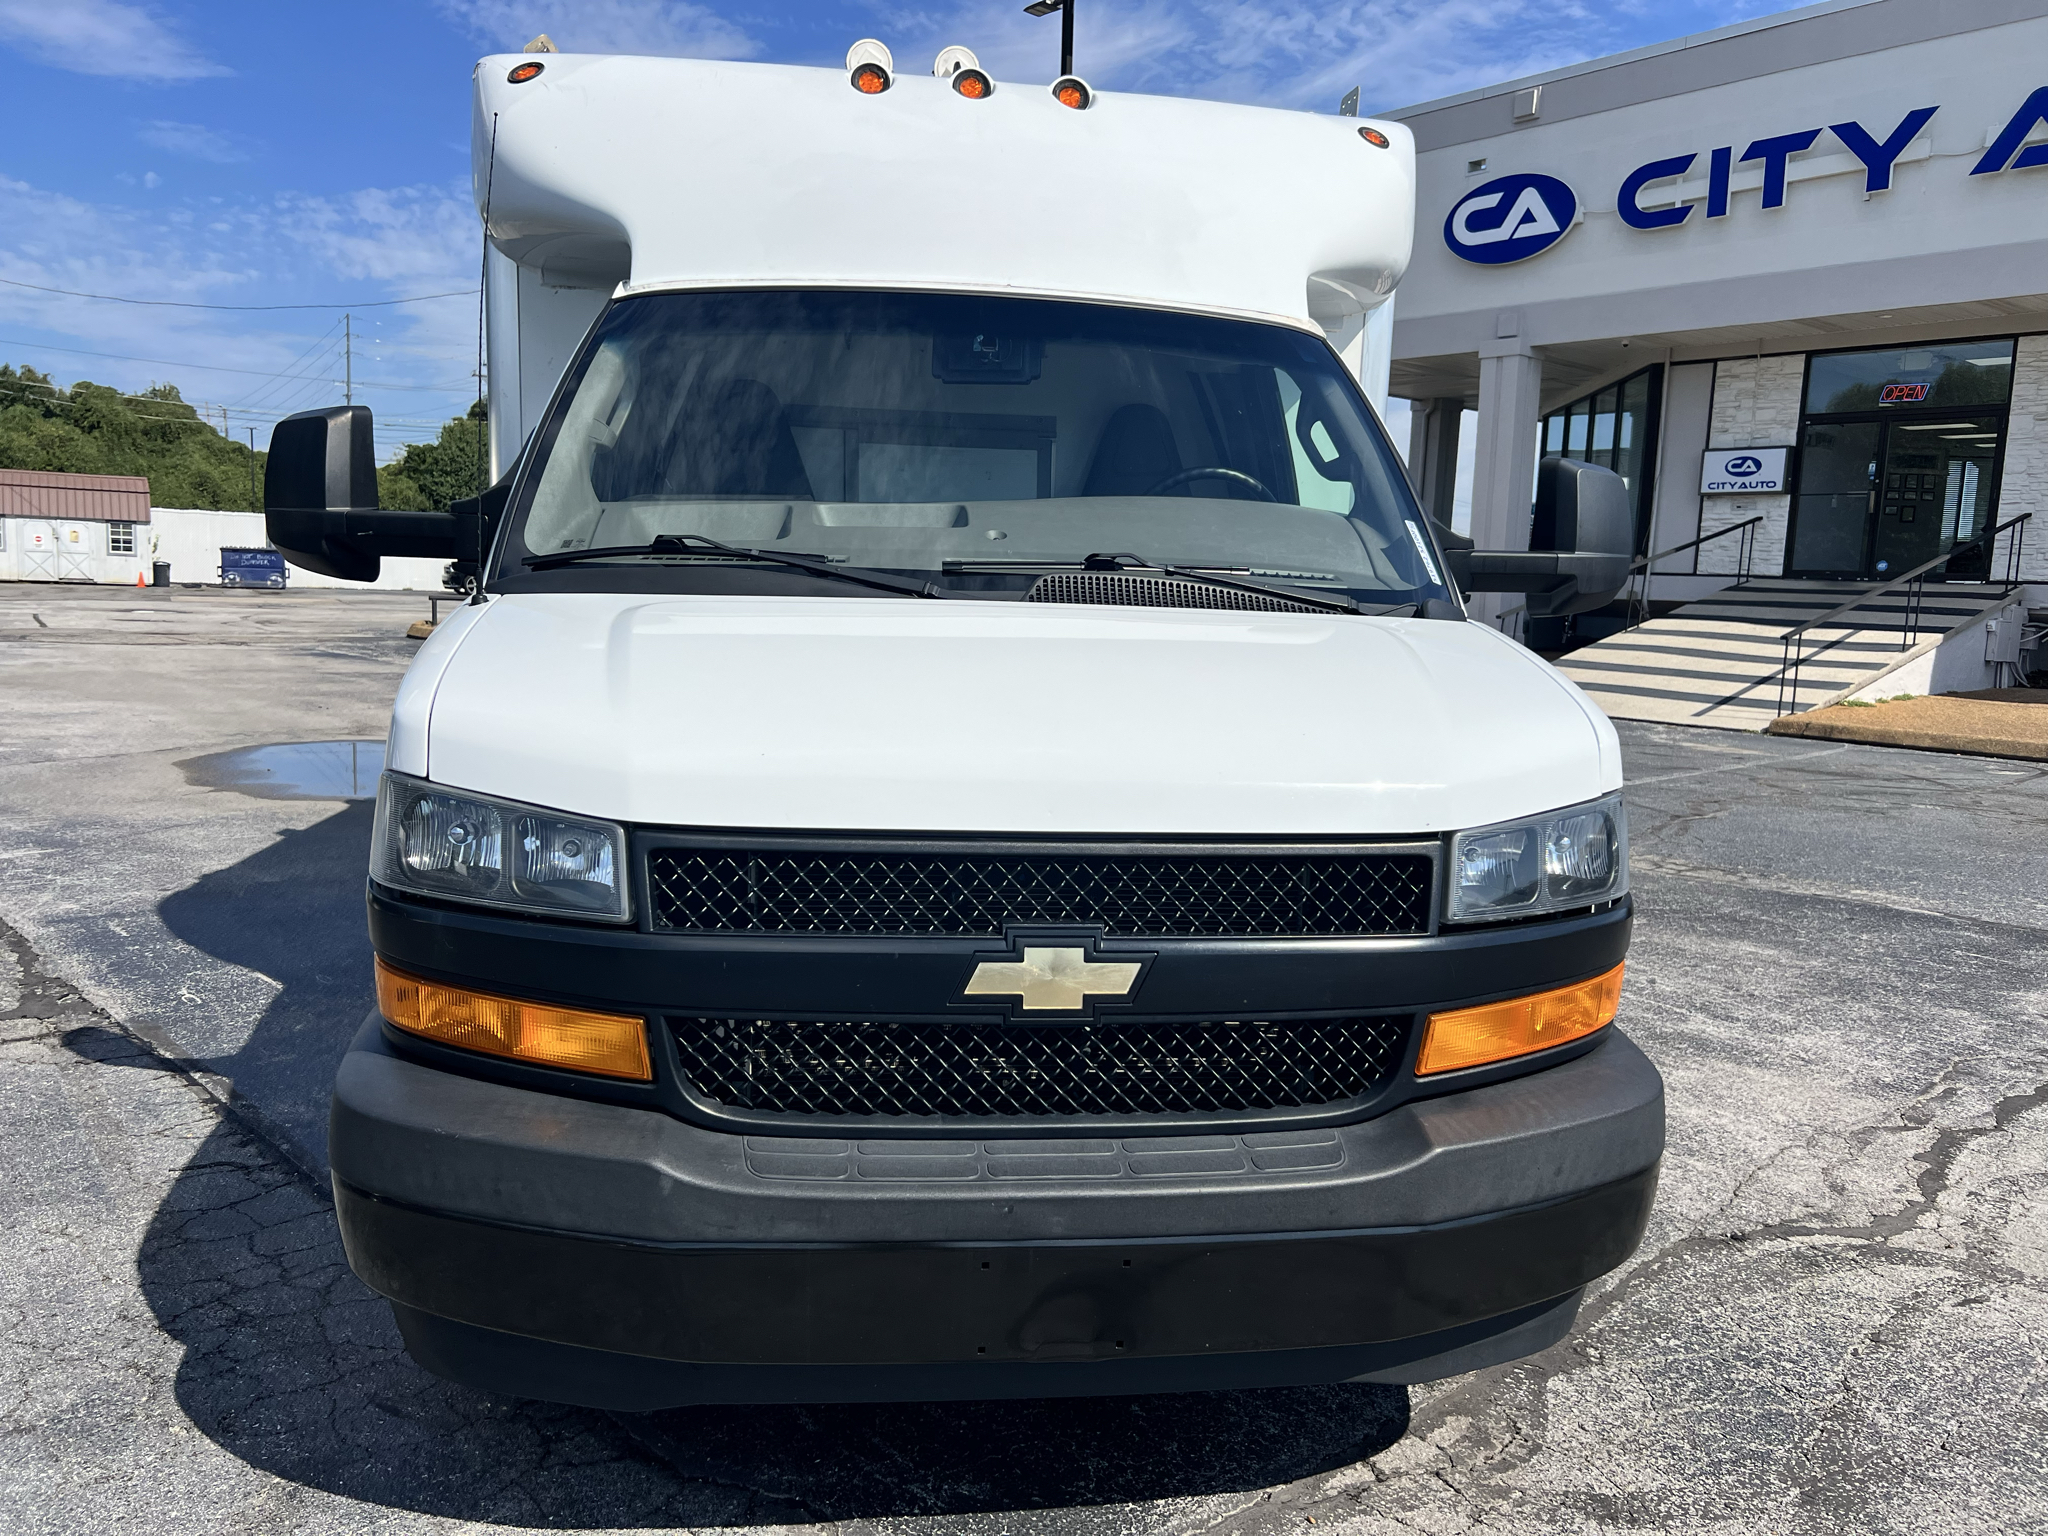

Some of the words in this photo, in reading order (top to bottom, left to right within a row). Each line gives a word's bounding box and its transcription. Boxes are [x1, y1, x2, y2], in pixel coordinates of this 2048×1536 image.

[1452, 186, 1561, 247] CA
[1617, 106, 1941, 231] CITY
[1883, 384, 1928, 400] OPEN
[1727, 459, 1758, 473] CA
